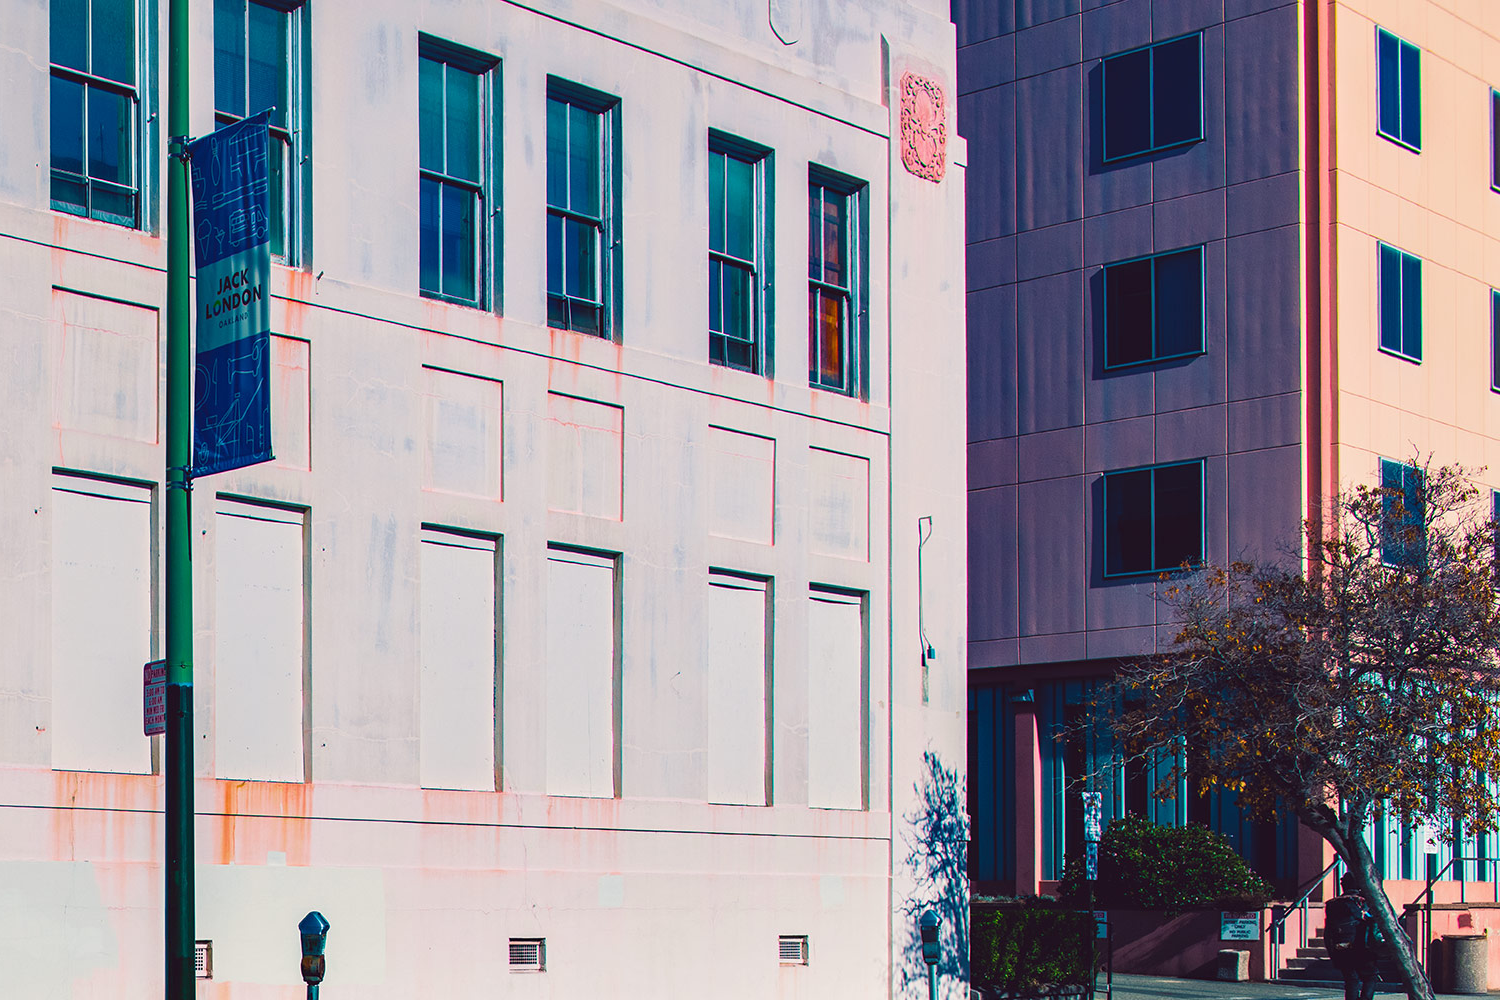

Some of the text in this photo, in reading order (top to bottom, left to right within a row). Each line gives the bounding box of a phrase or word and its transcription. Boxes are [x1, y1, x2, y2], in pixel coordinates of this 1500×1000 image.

[217, 268, 249, 295] JACK
[206, 284, 261, 319] LONDON
[219, 312, 248, 329] OAKLAND
